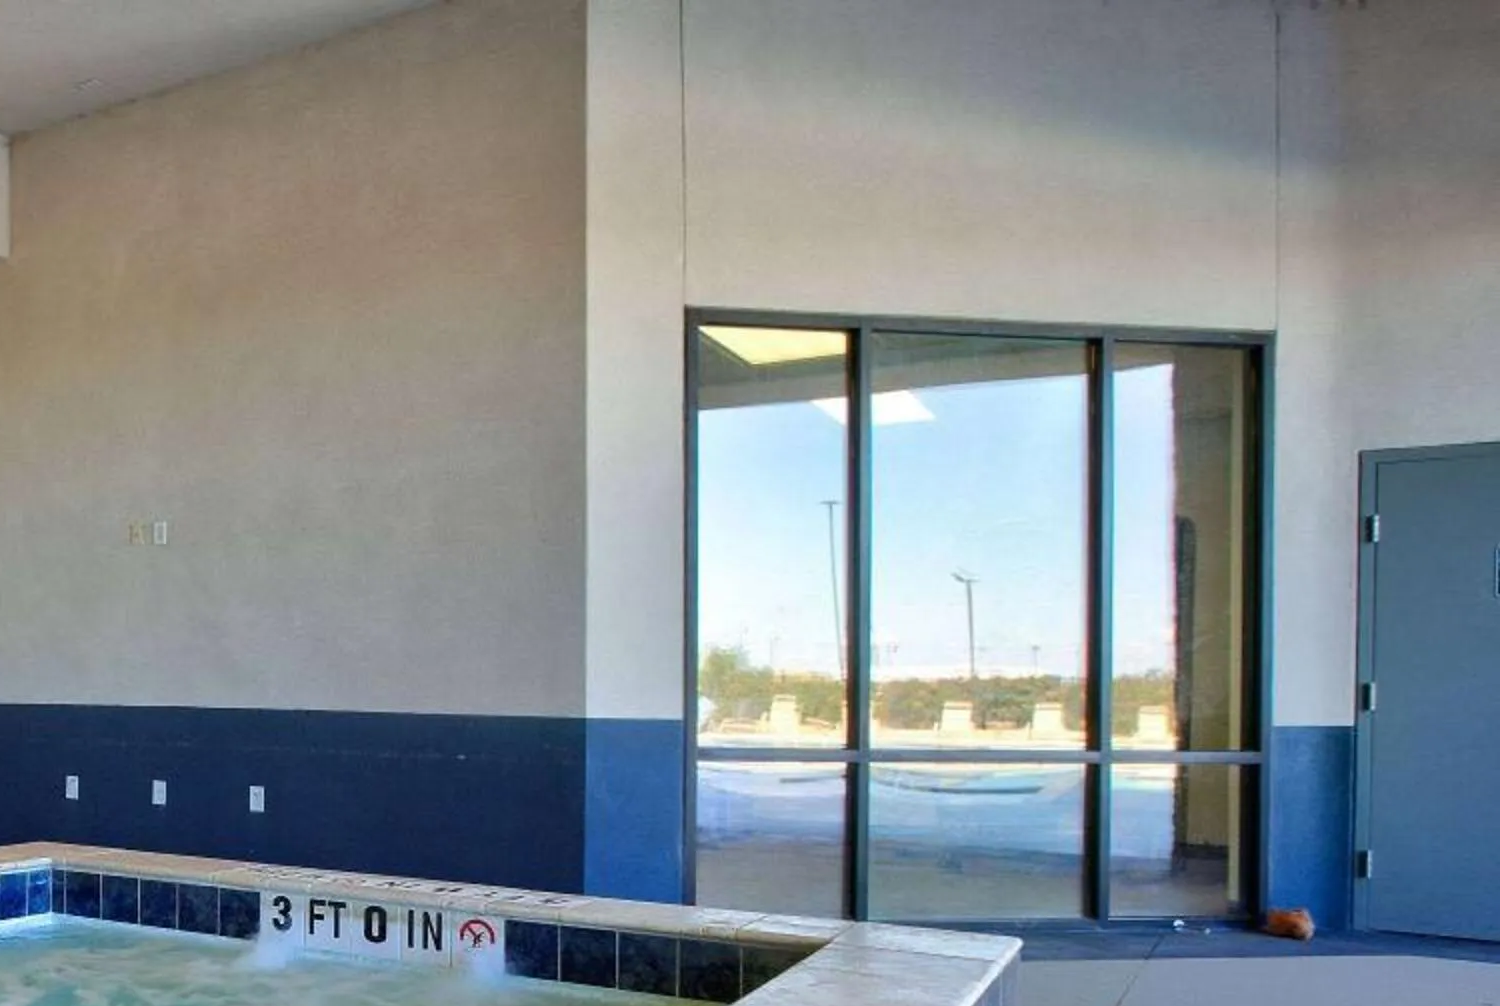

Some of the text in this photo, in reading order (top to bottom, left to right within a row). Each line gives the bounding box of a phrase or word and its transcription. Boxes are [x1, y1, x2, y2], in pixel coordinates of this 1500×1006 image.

[272, 896, 292, 930] 3
[309, 899, 347, 938] FT
[407, 909, 443, 950] IN
